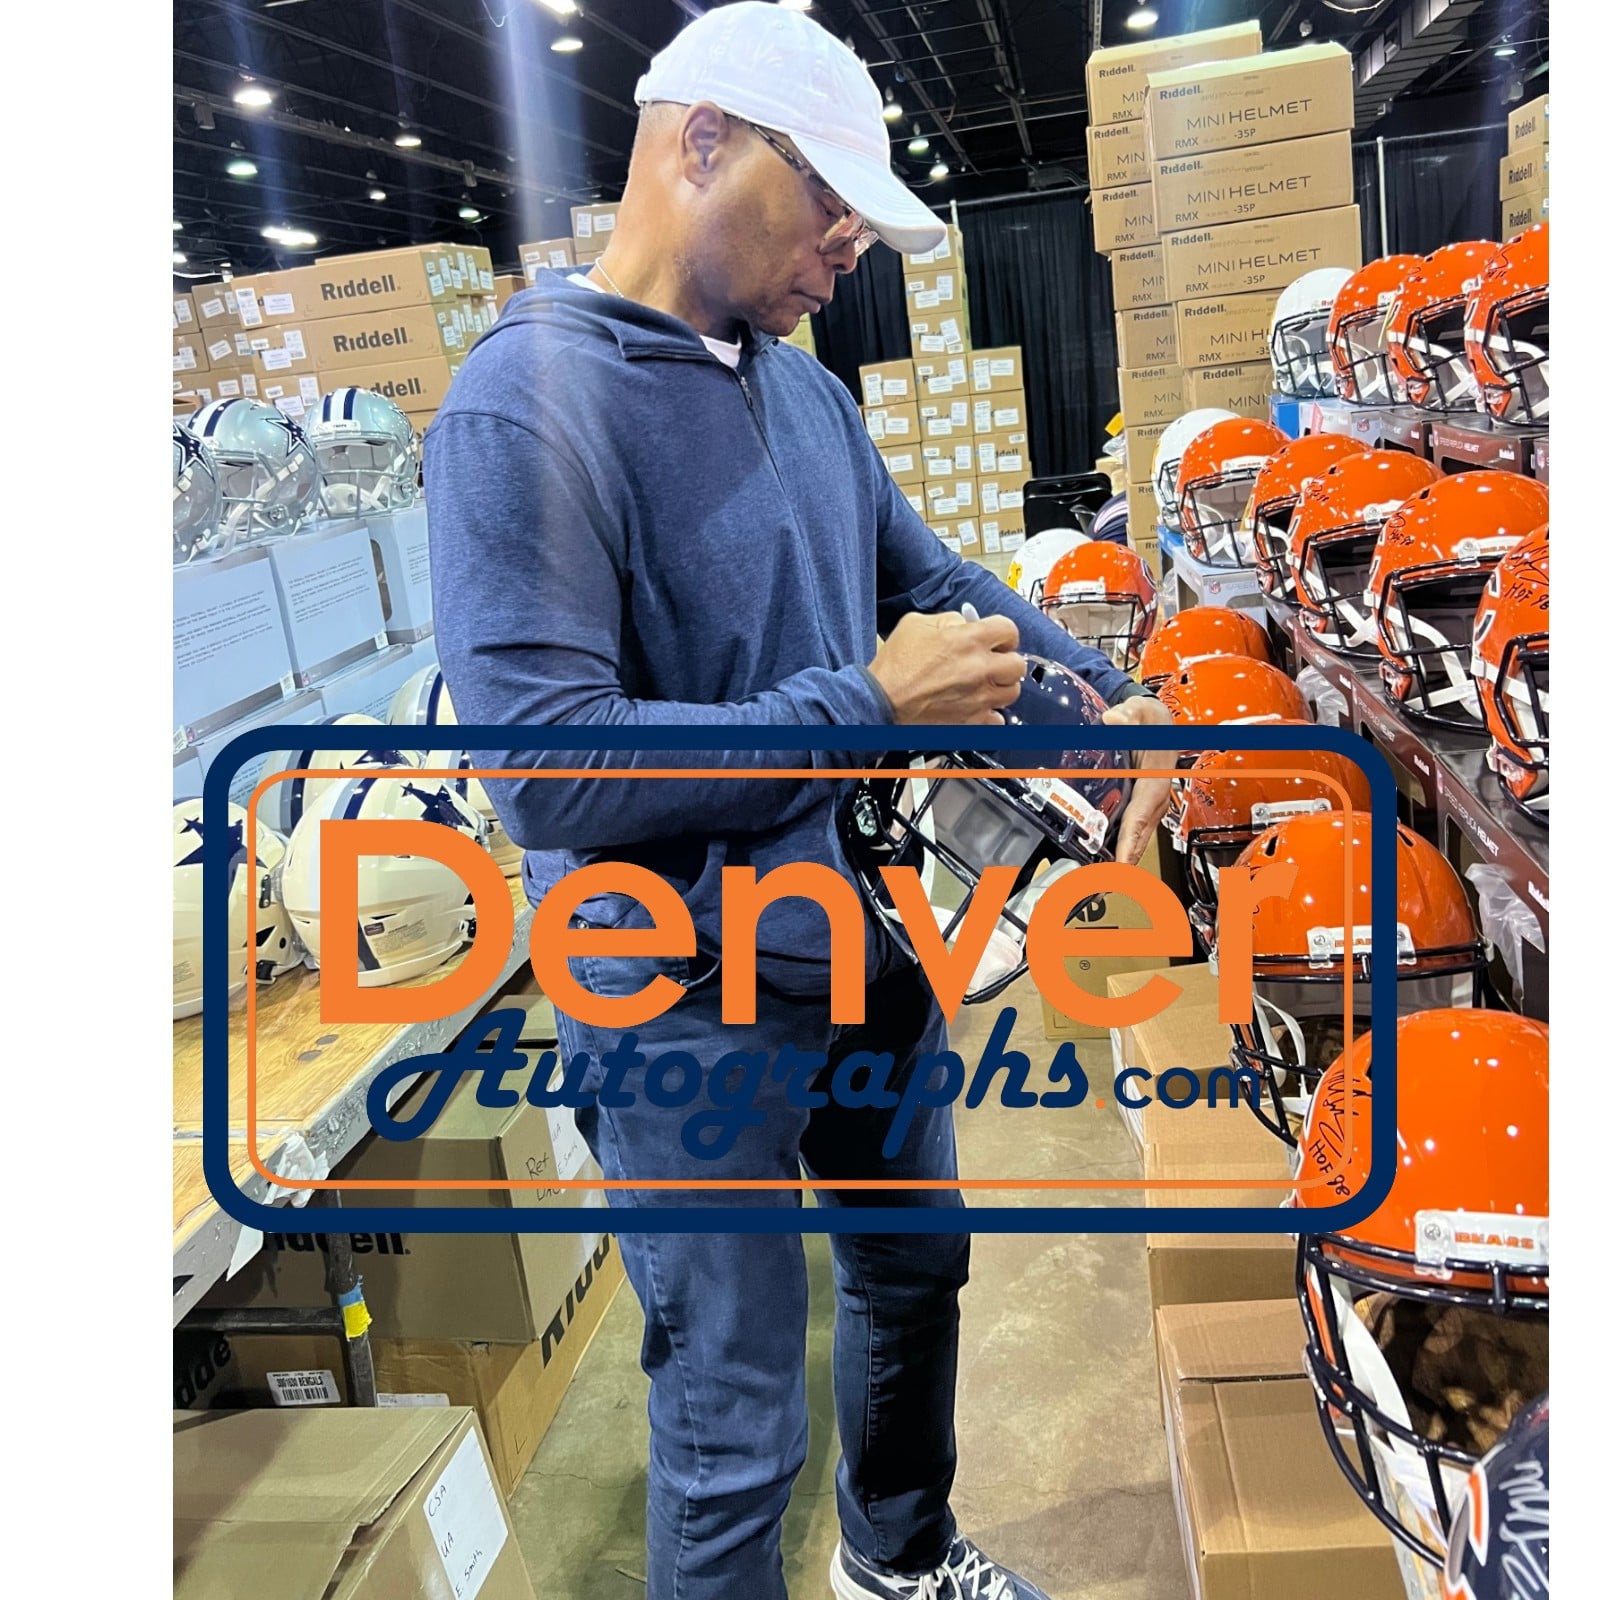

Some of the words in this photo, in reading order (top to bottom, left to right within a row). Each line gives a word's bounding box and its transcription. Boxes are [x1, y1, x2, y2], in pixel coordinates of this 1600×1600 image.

[1160, 85, 1201, 100] Riddell
[1229, 98, 1312, 124] HELMET
[1175, 137, 1199, 149] RMX
[1161, 161, 1201, 175] Riddell
[1229, 175, 1311, 199] HELMET
[1175, 211, 1199, 223] RMX
[1171, 233, 1211, 246] Riddell
[1239, 247, 1321, 270] HELMET
[320, 274, 396, 301] Riddell
[1185, 282, 1209, 293] RMX
[1184, 304, 1224, 317] Riddell
[333, 327, 408, 352] Riddell
[1203, 368, 1242, 380] Riddell
[1308, 1138, 1334, 1174] HOF
[1454, 1231, 1534, 1250] BEARS
